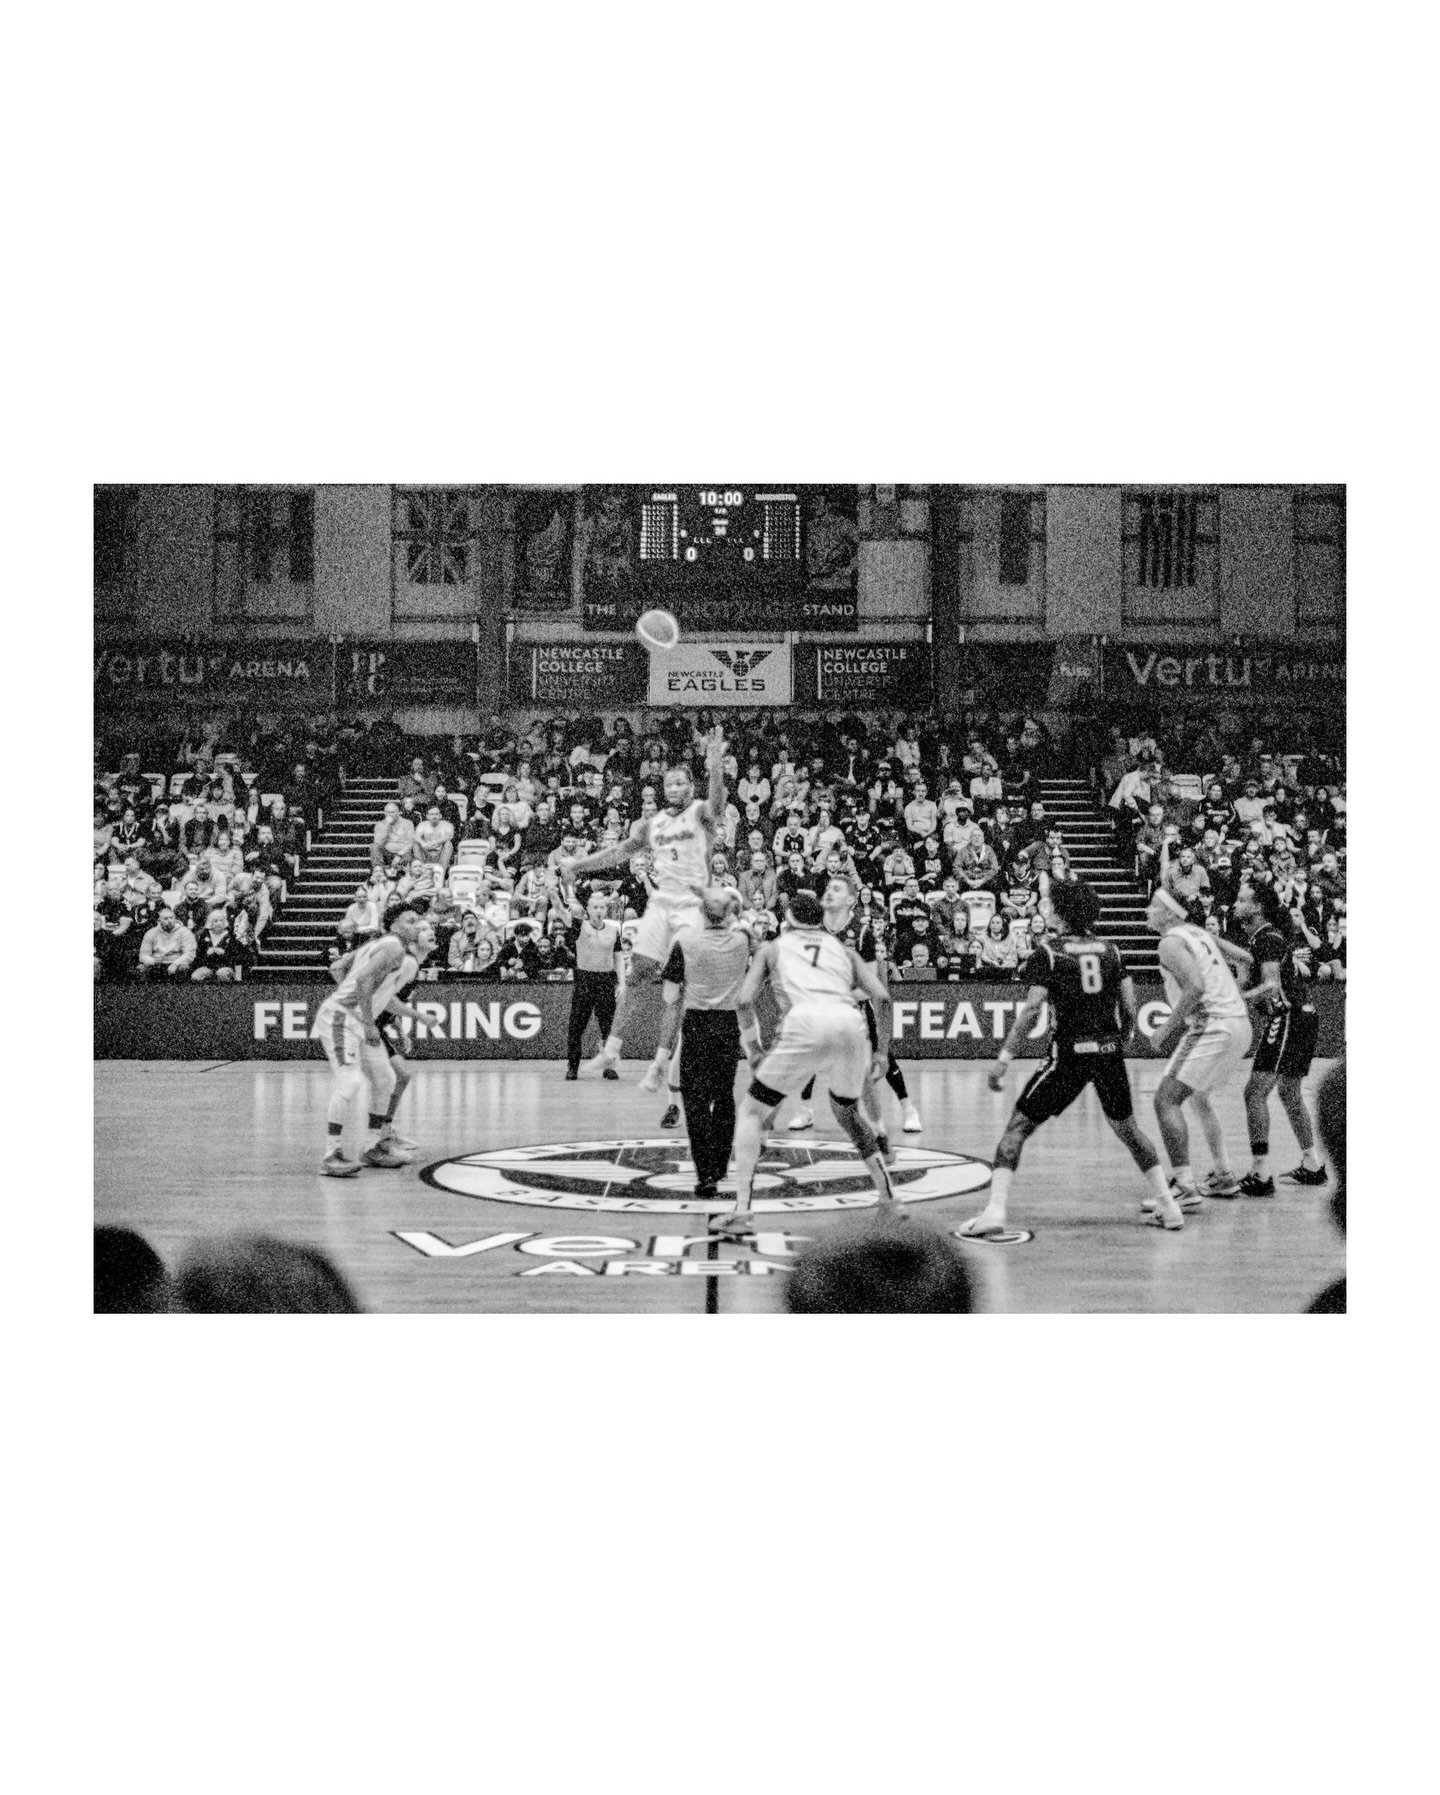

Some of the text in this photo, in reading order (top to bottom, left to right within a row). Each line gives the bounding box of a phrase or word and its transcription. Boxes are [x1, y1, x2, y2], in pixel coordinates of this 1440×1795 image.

[700, 491, 743, 506] 10:00
[685, 547, 697, 561] 0
[743, 547, 755, 561] 0
[586, 604, 616, 615] THE
[803, 604, 854, 616] STAND
[540, 648, 624, 659] NEWCASTLE
[824, 648, 907, 660] NEWCASTLE
[228, 661, 309, 677] ARENA
[540, 661, 603, 673] COLLEGE
[668, 670, 724, 678] NEWCASTLE
[824, 661, 888, 673] COLLEGE
[1125, 652, 1250, 685] Vertu
[668, 679, 765, 692] EAGLES
[804, 944, 821, 967] 7
[1080, 954, 1102, 993] 8
[254, 1002, 541, 1039] FEURING
[387, 1231, 812, 1258] Vert
[514, 1260, 797, 1277] AREN
